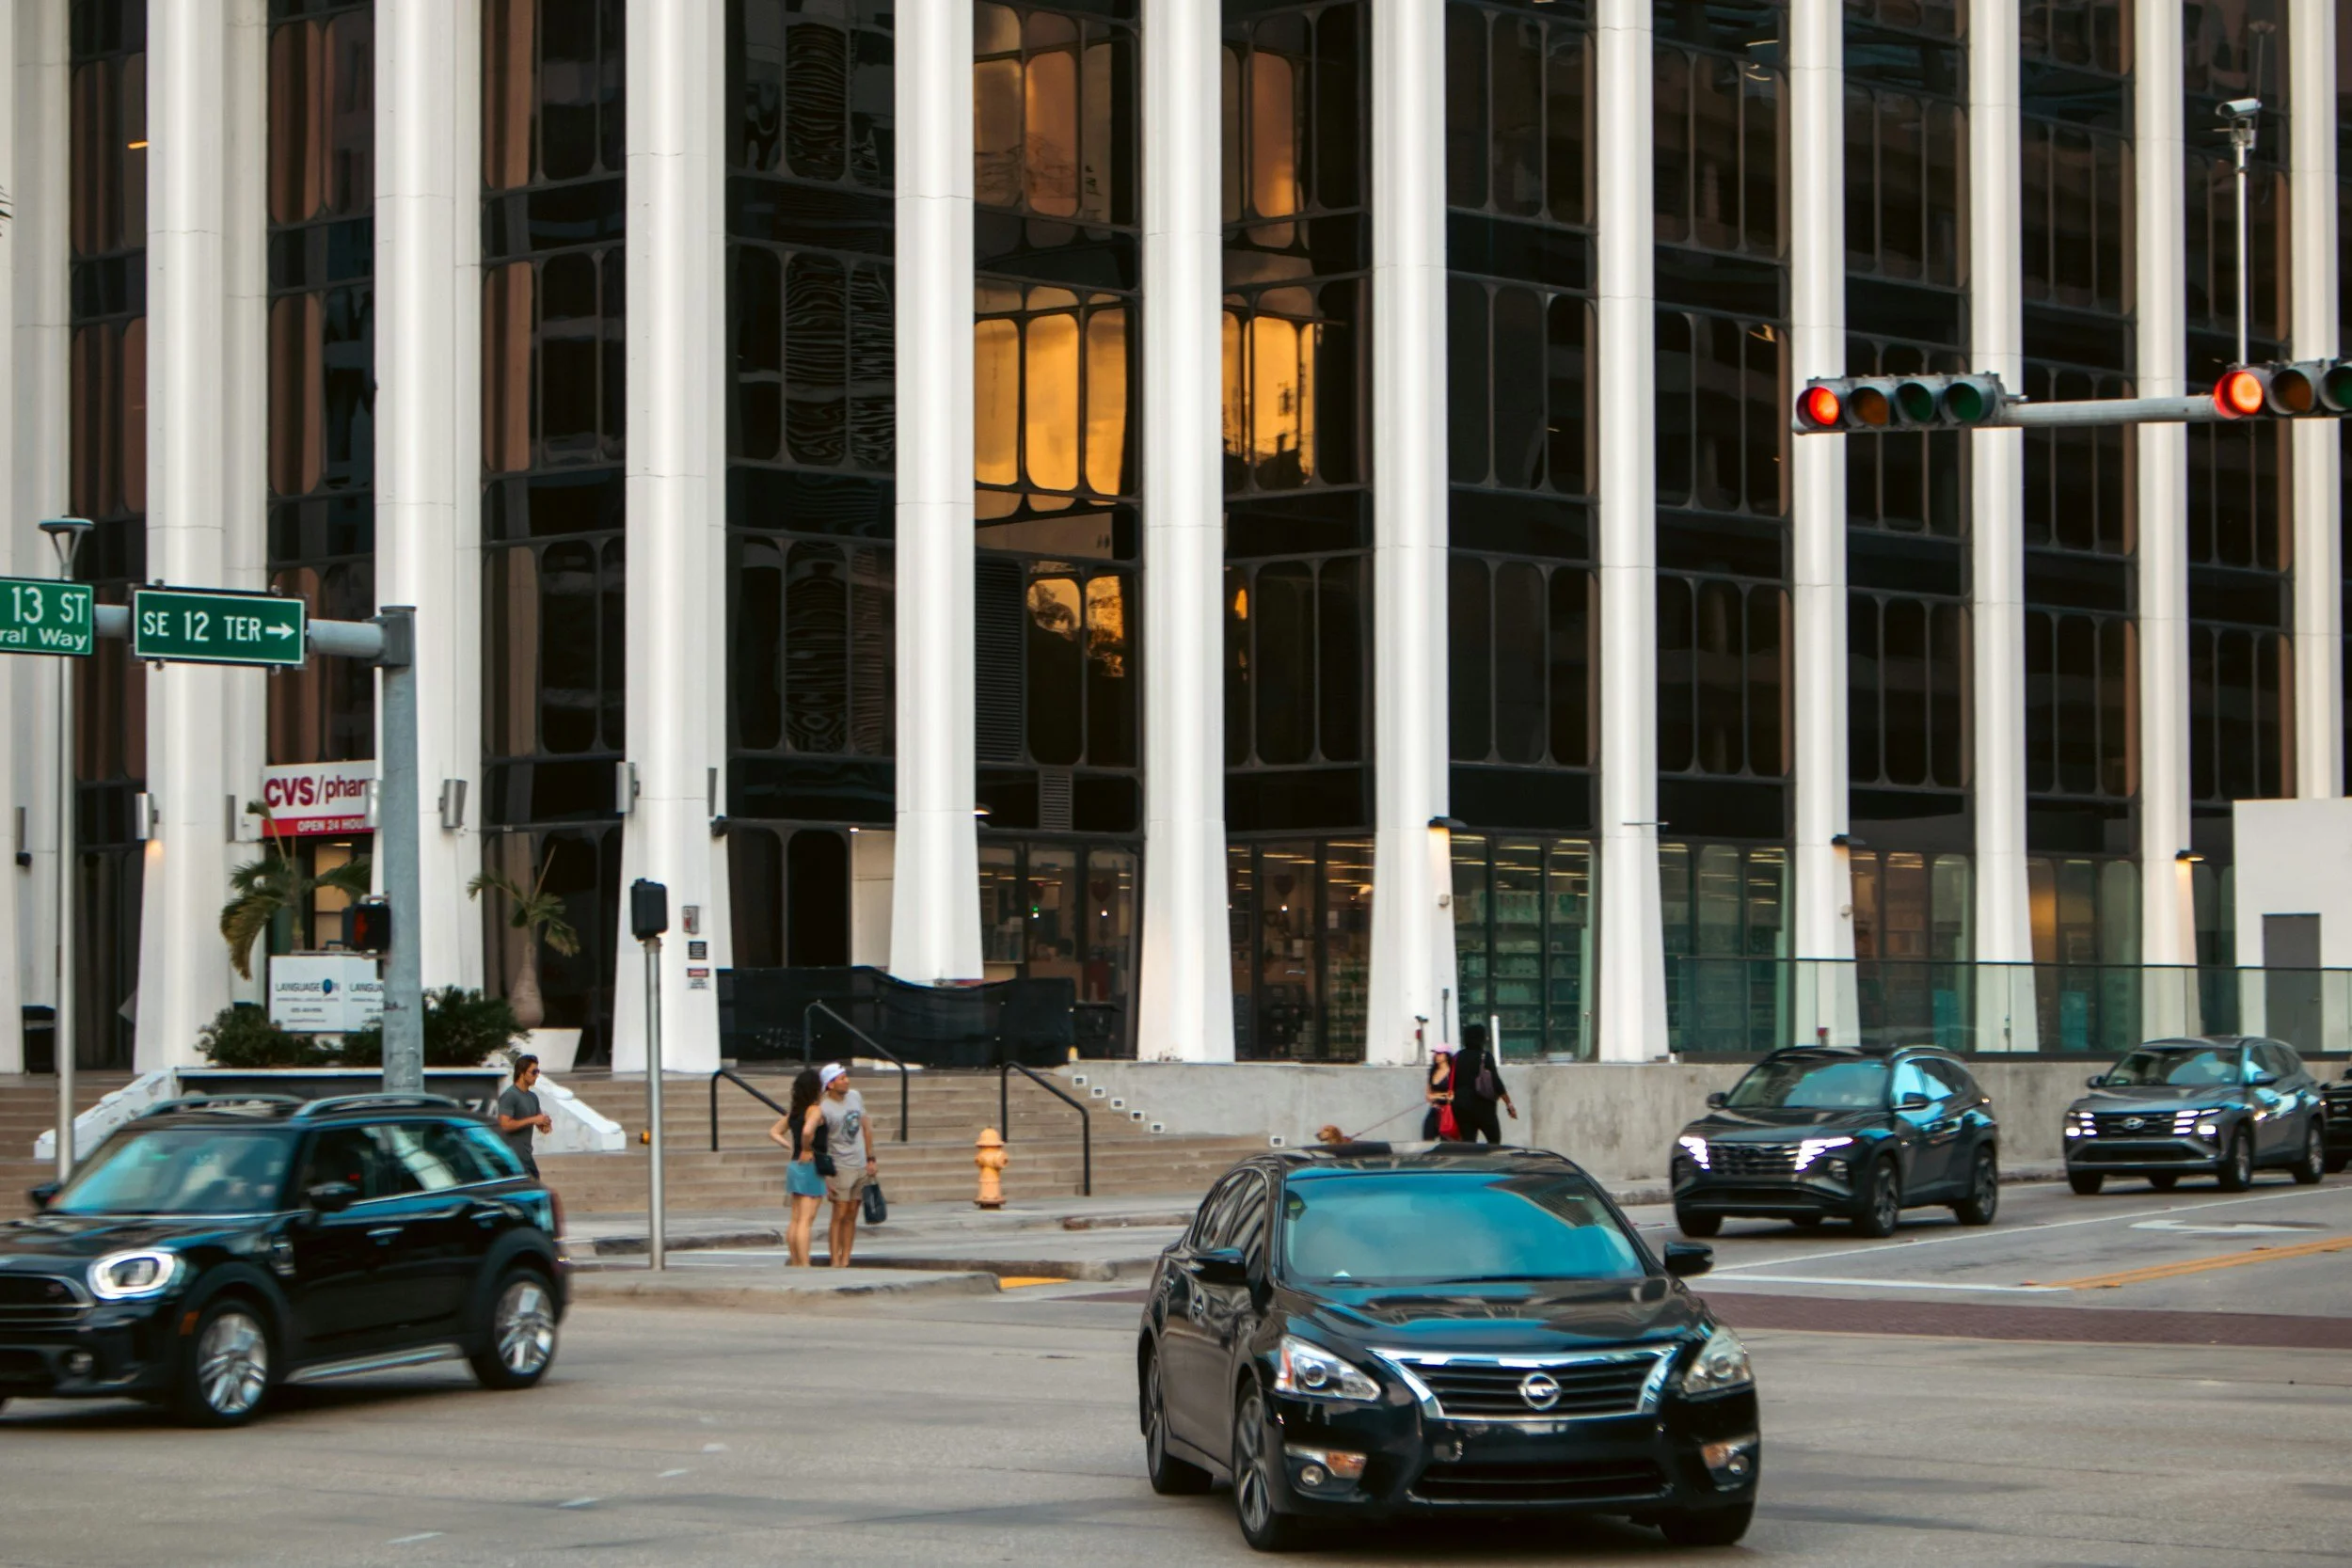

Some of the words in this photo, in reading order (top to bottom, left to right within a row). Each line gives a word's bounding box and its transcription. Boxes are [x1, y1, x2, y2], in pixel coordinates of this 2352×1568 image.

[11, 586, 44, 625] 13
[59, 592, 87, 624] ST
[38, 627, 87, 651] Way
[142, 610, 170, 637] SE
[183, 611, 210, 641] 12
[223, 615, 262, 641] TER
[263, 774, 369, 808] CVS/phar
[296, 819, 325, 832] OPEN
[327, 819, 340, 831] 24
[342, 817, 366, 830] HOU
[275, 982, 321, 992] LANGUAGE
